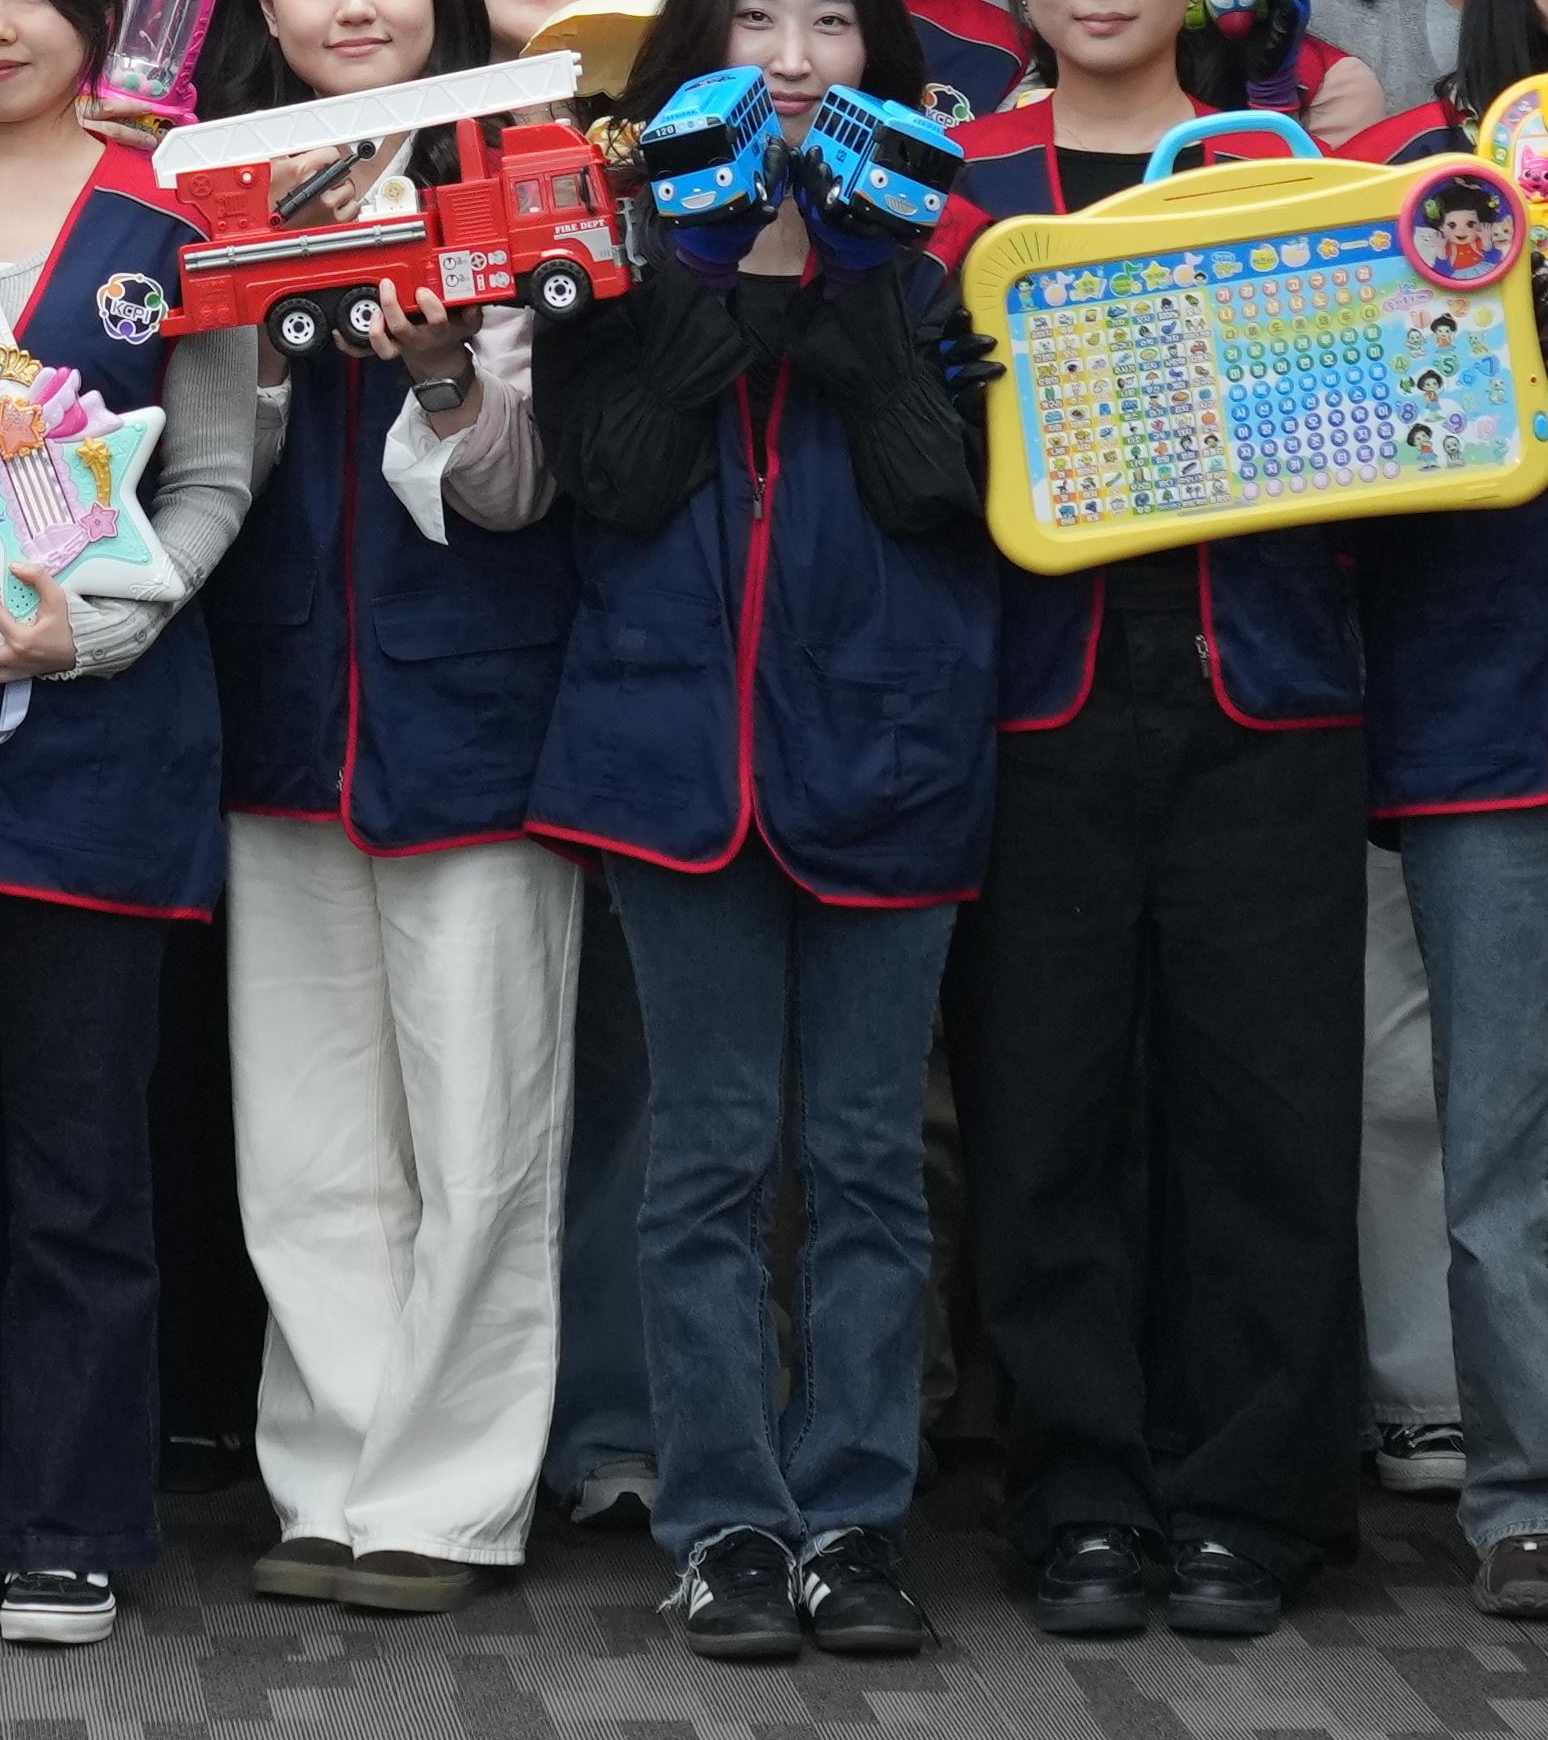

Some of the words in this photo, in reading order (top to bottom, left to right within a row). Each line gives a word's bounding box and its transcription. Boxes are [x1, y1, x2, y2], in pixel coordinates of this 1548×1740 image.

[654, 125, 674, 137] 120
[554, 223, 577, 235] FIRE
[579, 219, 606, 232] DEPT
[110, 299, 151, 325] KCPI
